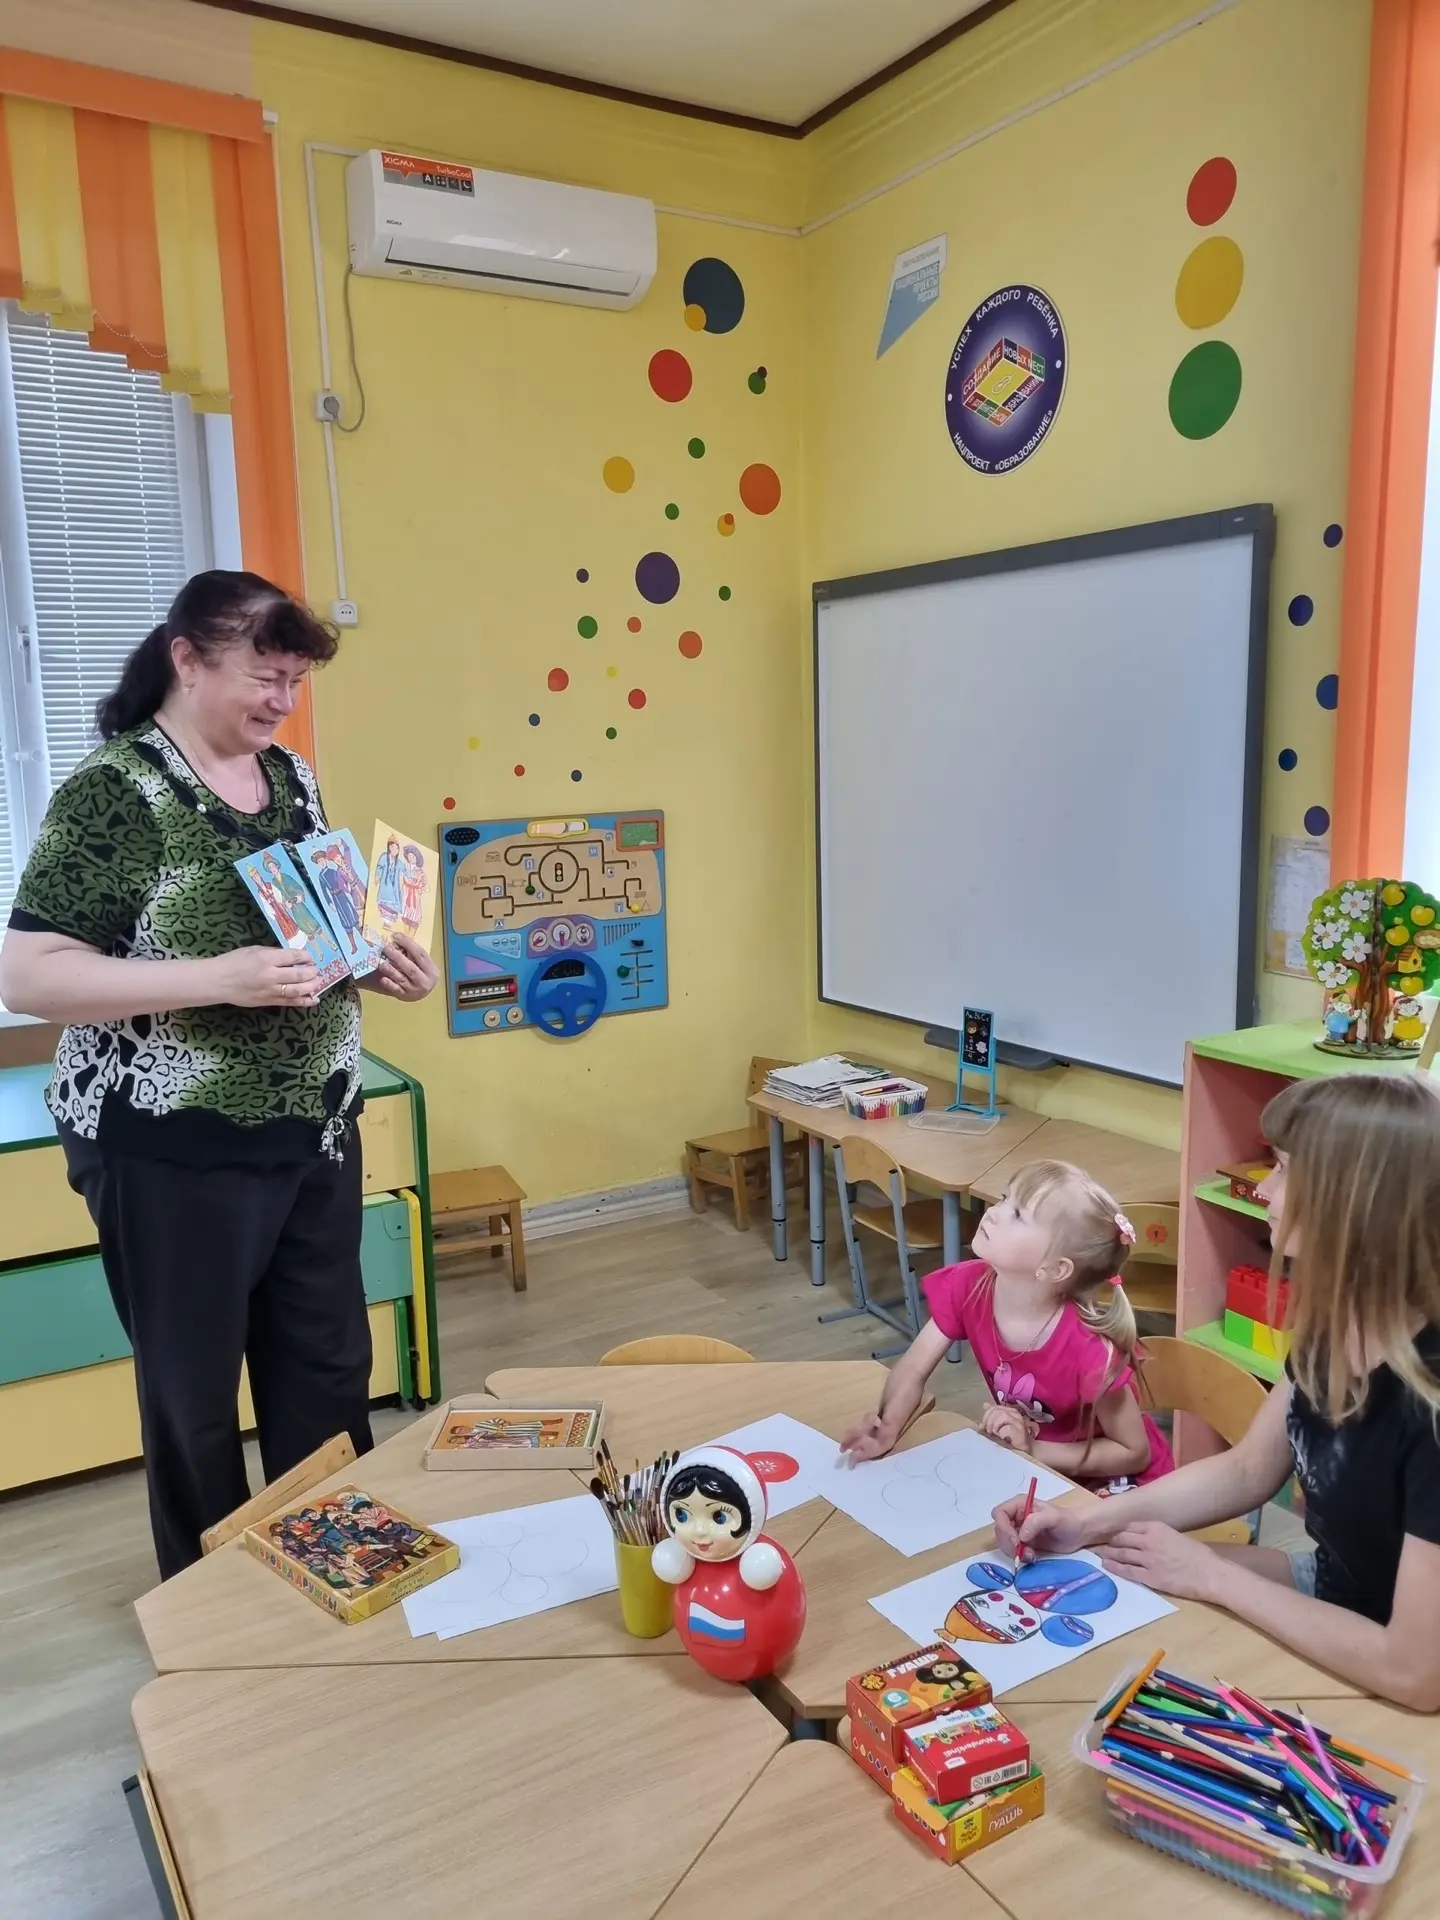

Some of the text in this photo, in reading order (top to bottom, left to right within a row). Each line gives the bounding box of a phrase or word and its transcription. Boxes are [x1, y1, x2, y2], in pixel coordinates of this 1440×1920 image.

[384, 156, 415, 168] XIGMA
[436, 165, 472, 179] TurboCool
[951, 289, 1059, 370] УСПЕХ КАЖДОГО РЕБЁНКА
[1003, 344, 1027, 365] НОВЫХ
[963, 346, 1002, 396] СОЗДАНИЕ
[954, 409, 1053, 471] НАЦПРОЕКТ «ОБРАЗОВАНИЕ»
[295, 1574, 337, 1611] ДРУЖБЫ
[886, 1652, 940, 1680] ГУАШЬ
[989, 1807, 1024, 1833] ГУАШЬ
